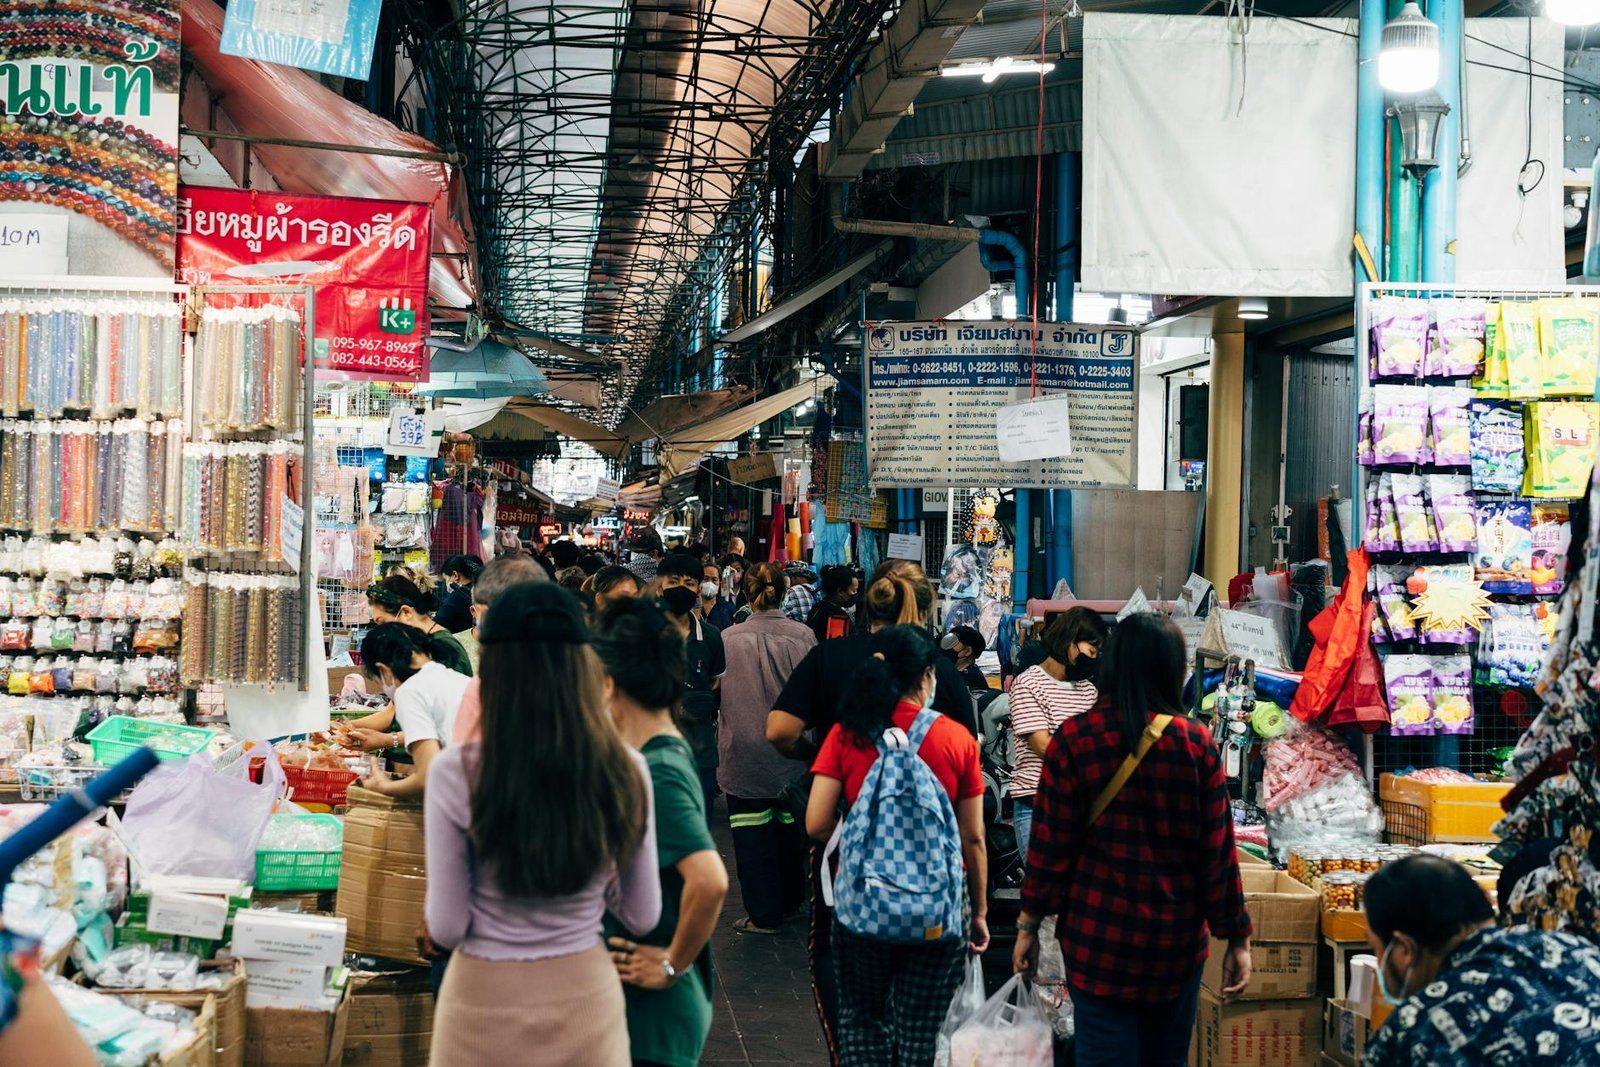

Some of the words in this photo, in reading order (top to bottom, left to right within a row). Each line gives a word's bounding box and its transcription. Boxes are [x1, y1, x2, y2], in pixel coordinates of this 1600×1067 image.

[382, 310, 411, 329] K+
[900, 325, 947, 341] บริษัท
[1052, 327, 1097, 345] จำกัด
[333, 336, 416, 354] 095-967-8962
[331, 352, 415, 369] 082-443-0564
[912, 361, 966, 375] 0-2622-8451,
[1079, 366, 1131, 378] 0-2225-3403
[873, 377, 970, 387] www.jiamsamarn.com
[977, 376, 1006, 385] E-mail
[924, 492, 948, 503] GIOV
